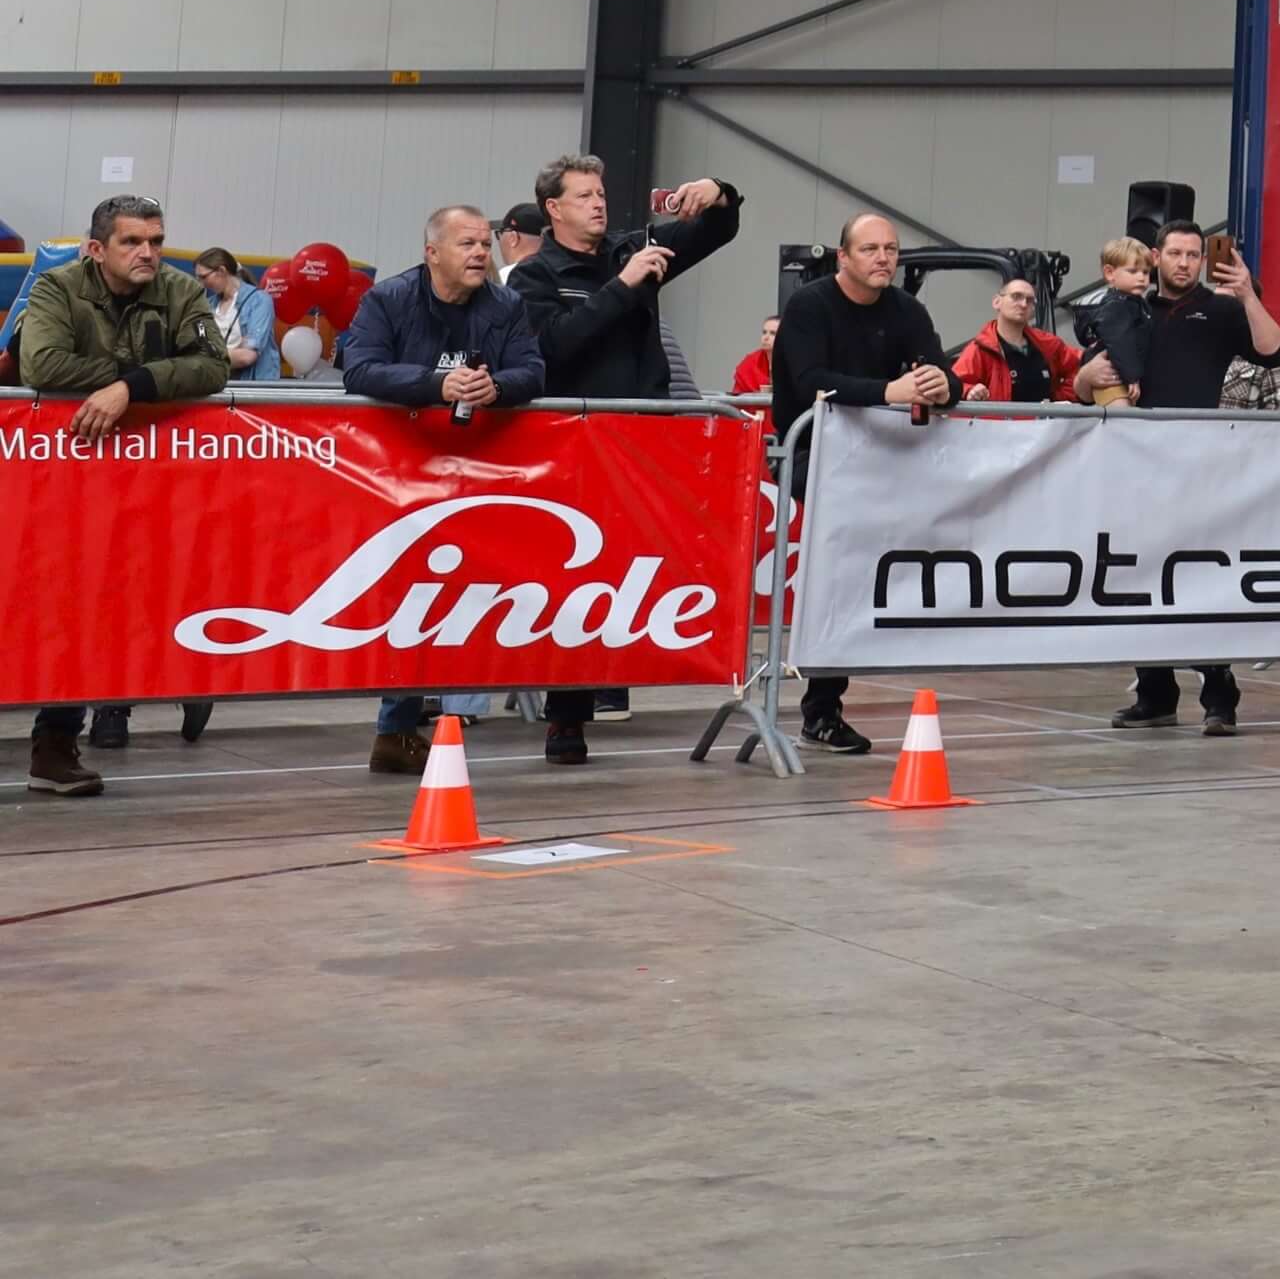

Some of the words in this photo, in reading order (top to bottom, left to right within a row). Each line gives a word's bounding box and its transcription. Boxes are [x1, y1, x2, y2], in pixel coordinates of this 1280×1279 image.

[0, 423, 156, 460] Material
[171, 423, 336, 468] Handling
[174, 495, 716, 654] Linde
